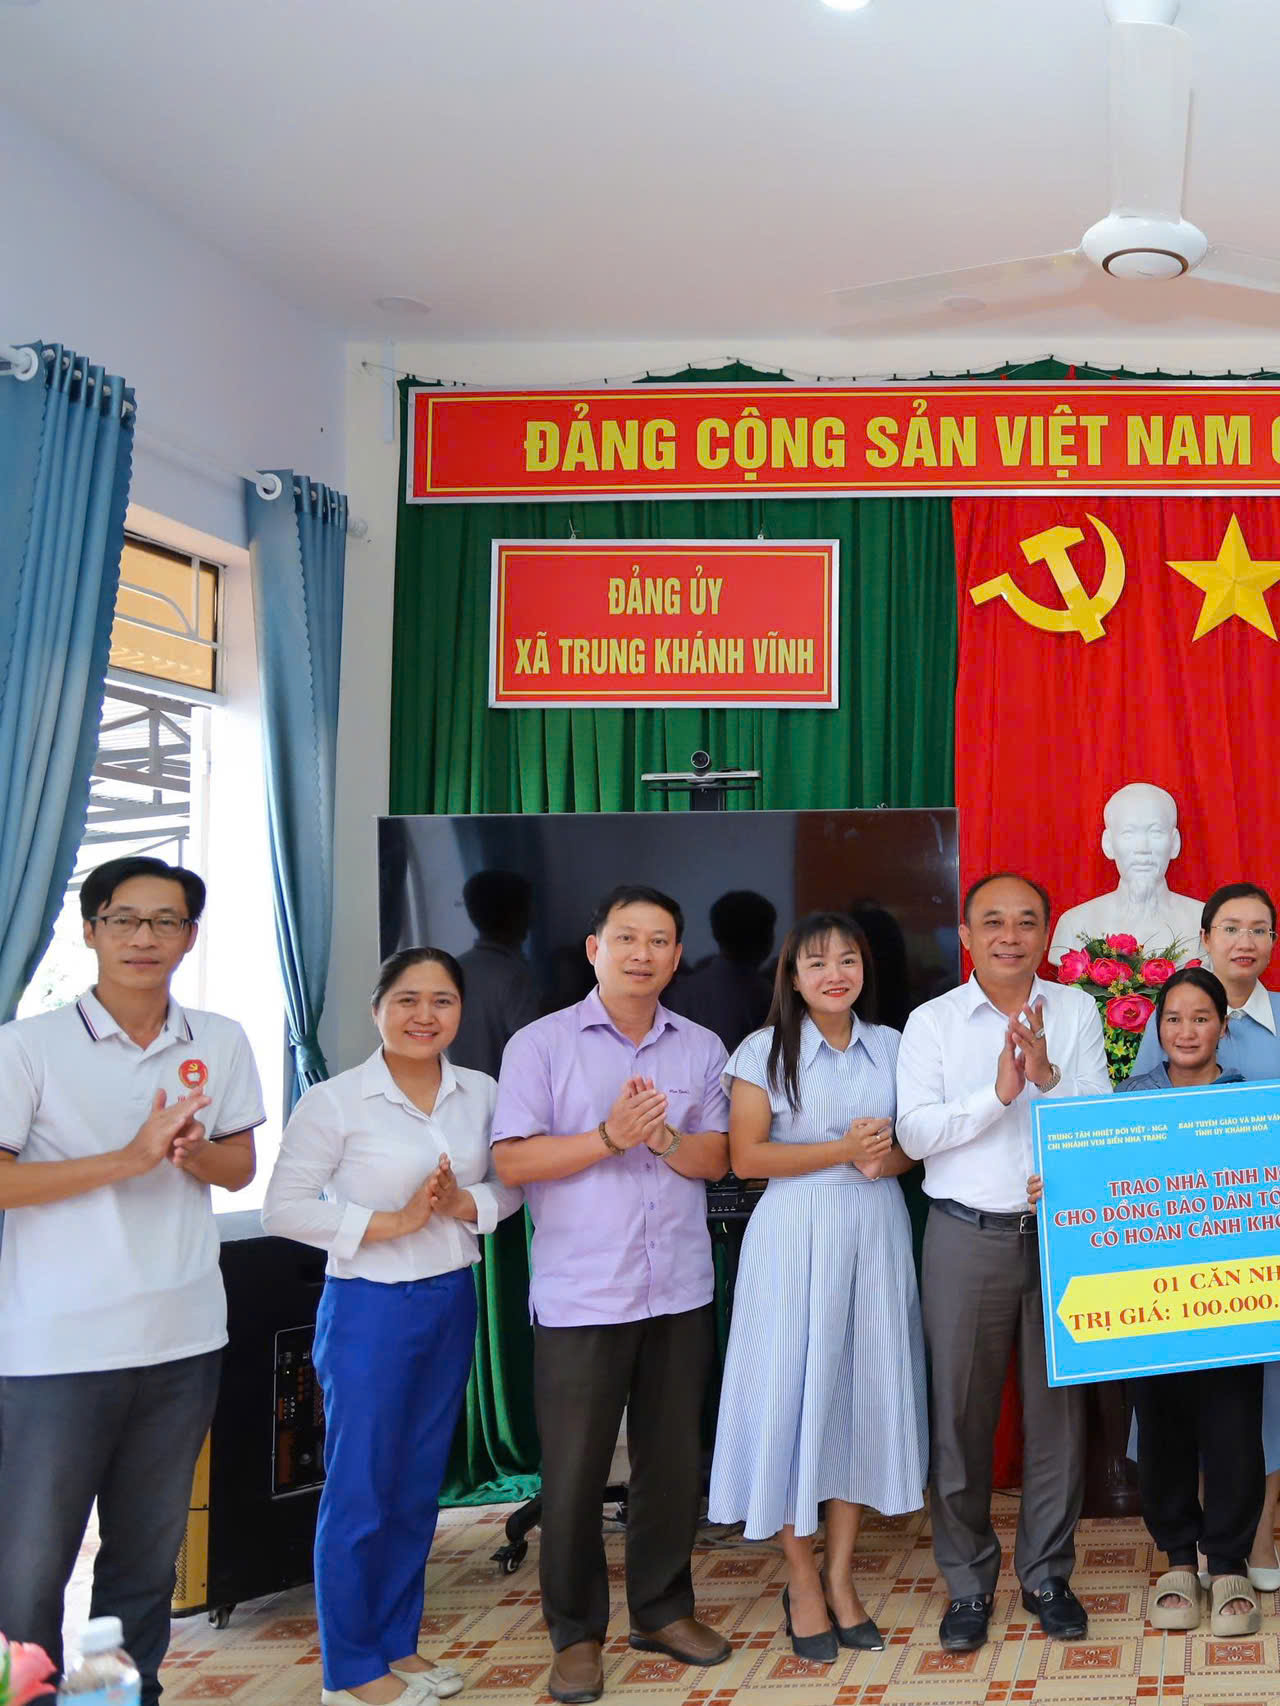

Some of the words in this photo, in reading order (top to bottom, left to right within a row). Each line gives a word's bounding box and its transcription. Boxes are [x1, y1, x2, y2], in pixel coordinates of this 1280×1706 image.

[524, 402, 676, 472] ĐẢNG
[696, 406, 846, 481] CỘNG
[865, 399, 977, 468] SẢN
[995, 404, 1109, 478] VIỆT
[1127, 415, 1251, 466] NAM
[608, 565, 681, 615] ĐẢNG
[689, 565, 723, 615] ỦY
[515, 631, 551, 675] XÃ
[559, 638, 646, 675] TRUNG
[654, 631, 744, 674] KHÁNH
[752, 631, 814, 674] VĨNH
[1048, 1133, 1073, 1142] TRUNG
[1152, 1123, 1169, 1132] NGA
[1178, 1121, 1193, 1129] BAN
[1048, 1142, 1061, 1150] CHI
[1143, 1133, 1167, 1142] TRANG
[1109, 1177, 1161, 1197] TRAO
[1166, 1168, 1208, 1192] NHÀ
[1213, 1166, 1259, 1187] TÌNH
[1054, 1208, 1097, 1227] CHO
[1102, 1199, 1160, 1223] ĐỒNG
[1166, 1195, 1206, 1216] BÀO
[1212, 1191, 1252, 1211] DÂN
[1090, 1226, 1119, 1248] CÓ
[1124, 1222, 1182, 1245] HOÀN
[1188, 1215, 1242, 1238] CẢNH
[1153, 1276, 1179, 1294] 01
[1190, 1267, 1240, 1290] CĂN
[1069, 1311, 1111, 1331] TRỊ
[1119, 1300, 1170, 1325] GIÁ:
